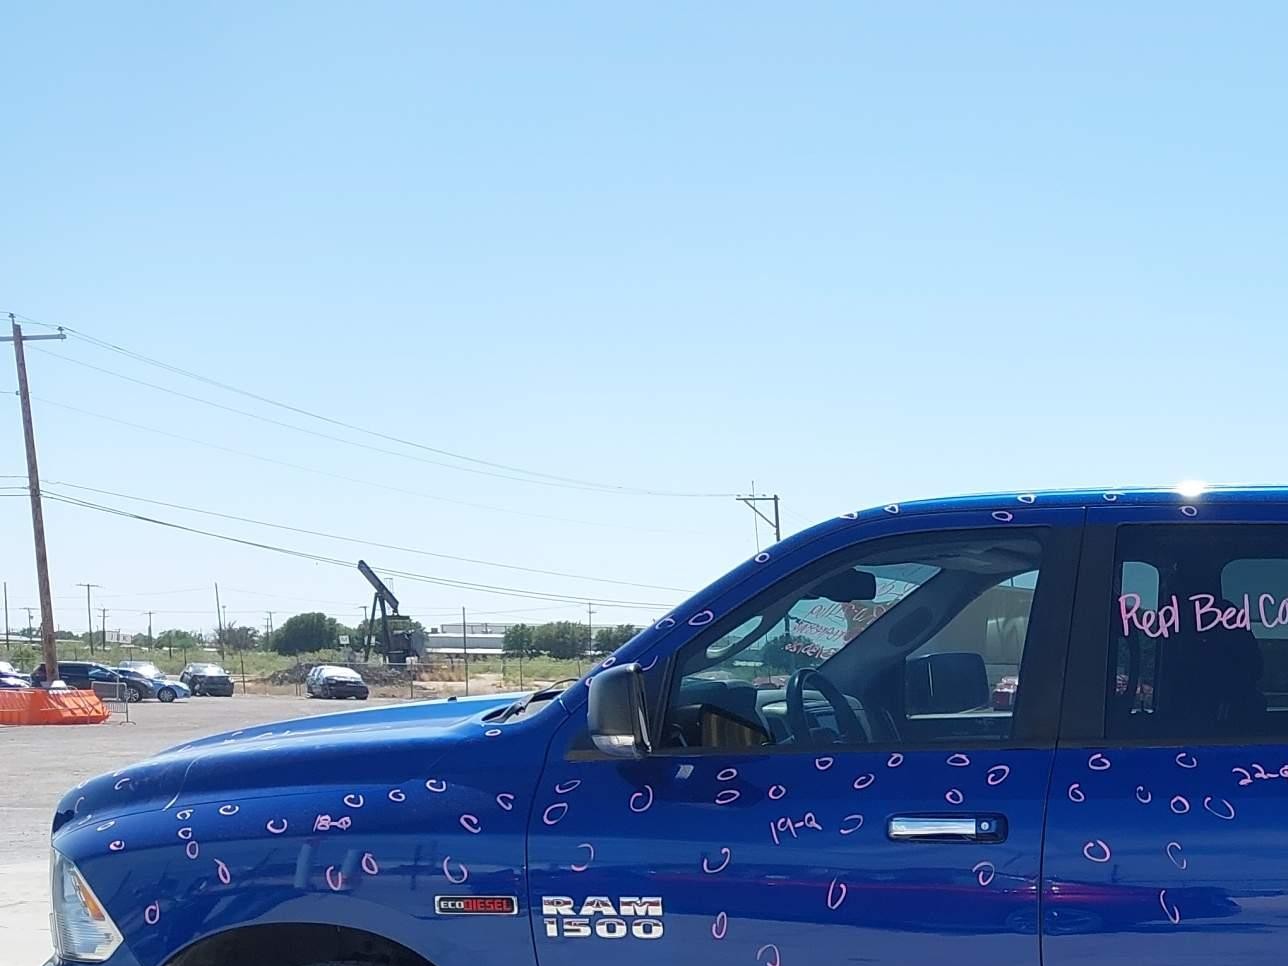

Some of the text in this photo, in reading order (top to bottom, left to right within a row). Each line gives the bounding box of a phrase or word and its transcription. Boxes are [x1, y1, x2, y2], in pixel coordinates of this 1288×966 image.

[1188, 593, 1251, 632] Bed
[440, 900, 512, 912] ECODIESEL
[542, 896, 663, 916] RAM
[543, 918, 664, 939] 1500
